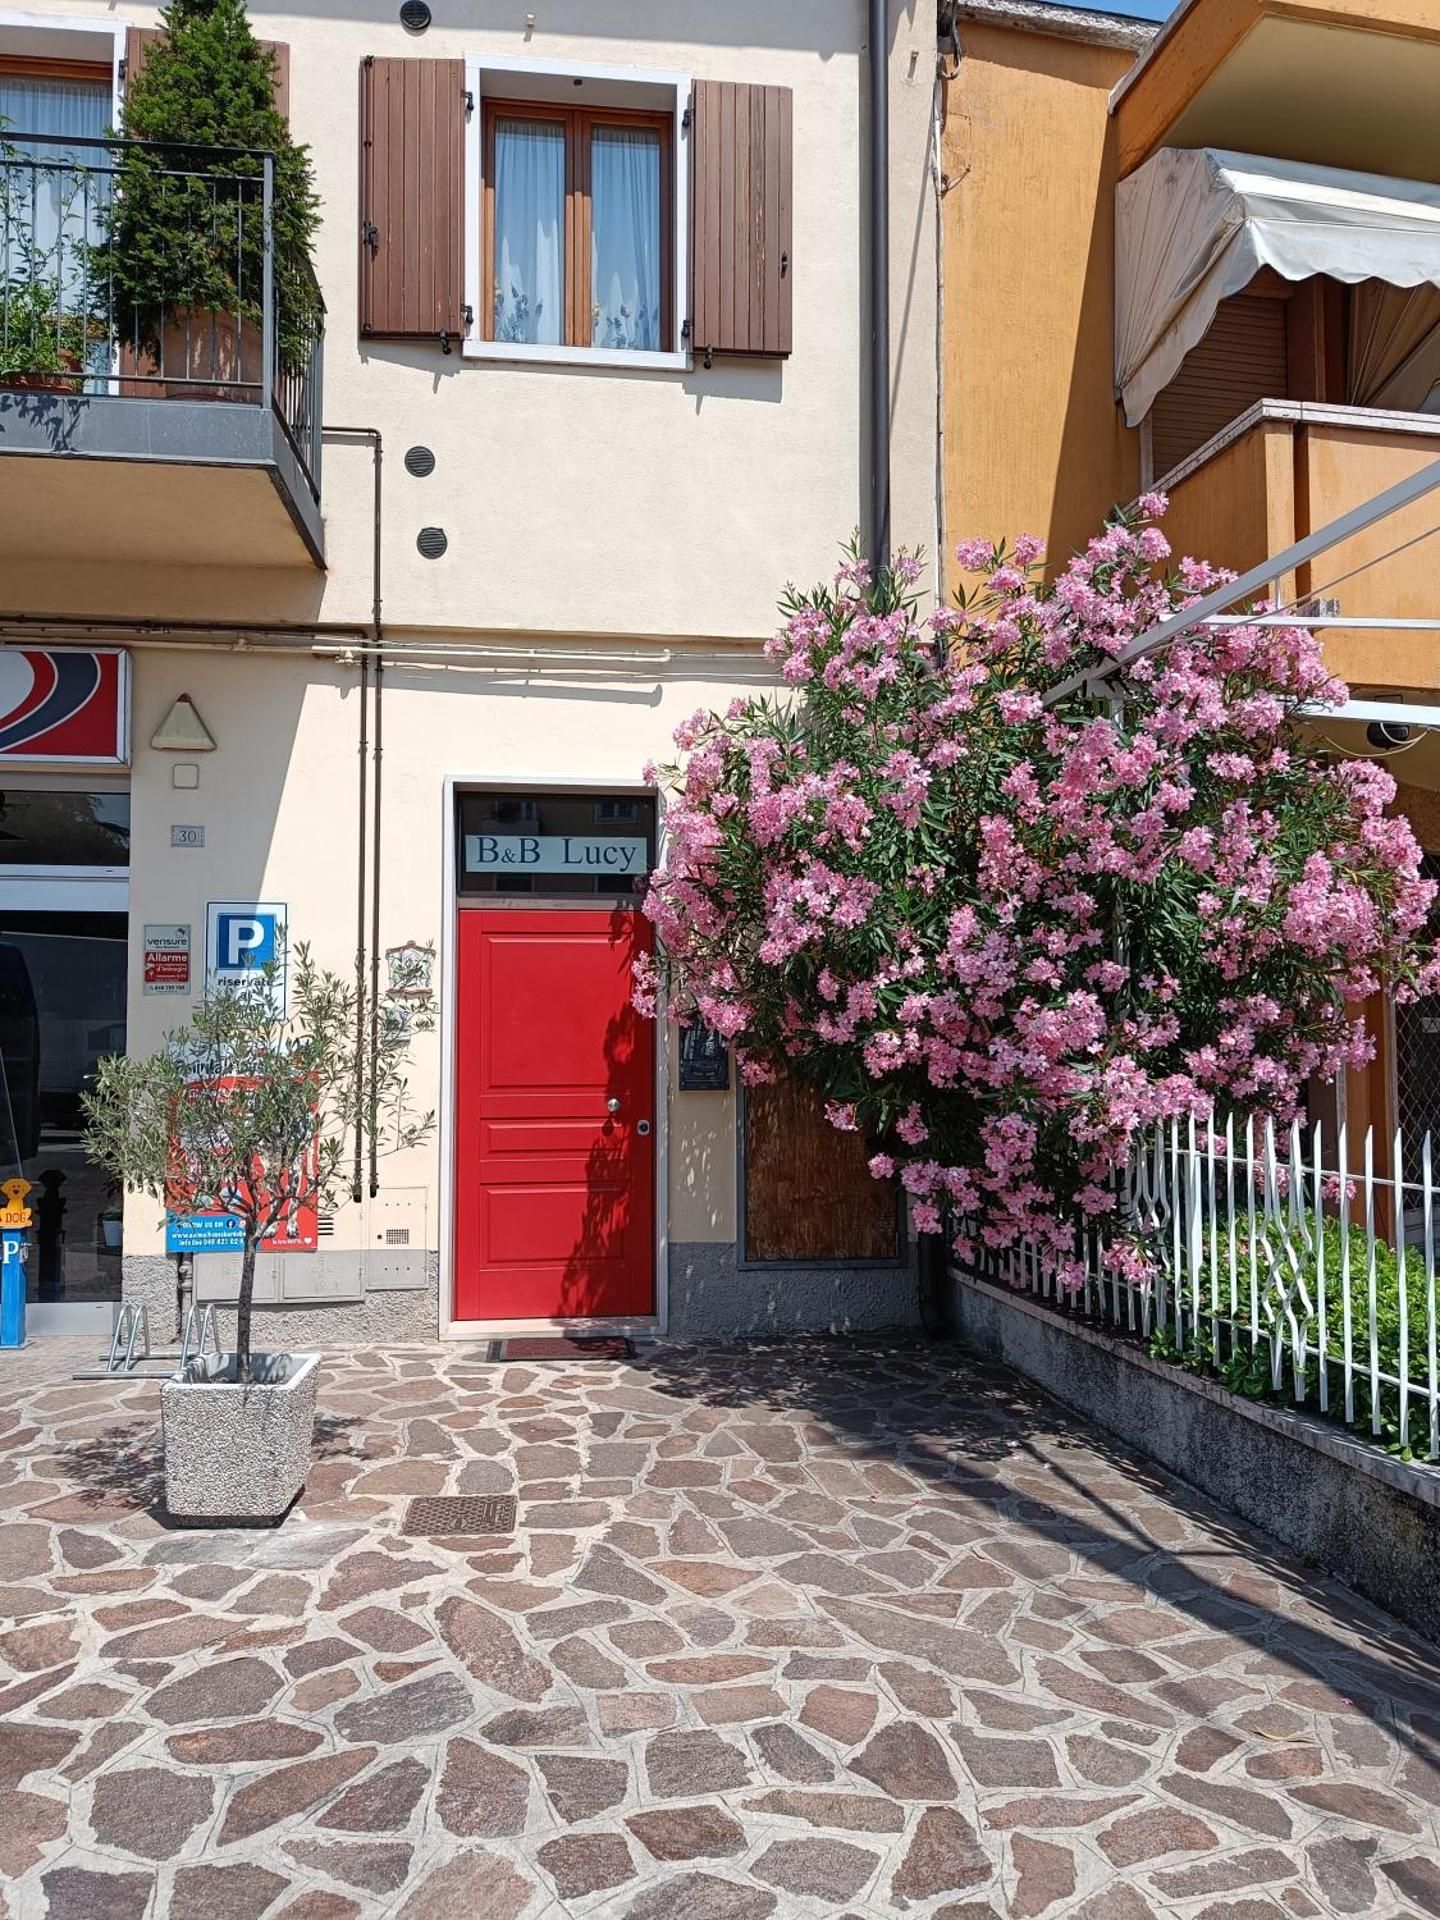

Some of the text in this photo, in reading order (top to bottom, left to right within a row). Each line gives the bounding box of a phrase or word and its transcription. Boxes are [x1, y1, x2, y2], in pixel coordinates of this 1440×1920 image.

[178, 830, 197, 843] 30
[476, 836, 638, 872] B&B Lucy
[146, 937, 188, 946] verisure
[228, 919, 264, 964] P
[147, 953, 188, 962] Allarme
[6, 1212, 27, 1223] DOG
[2, 1240, 19, 1264] P
